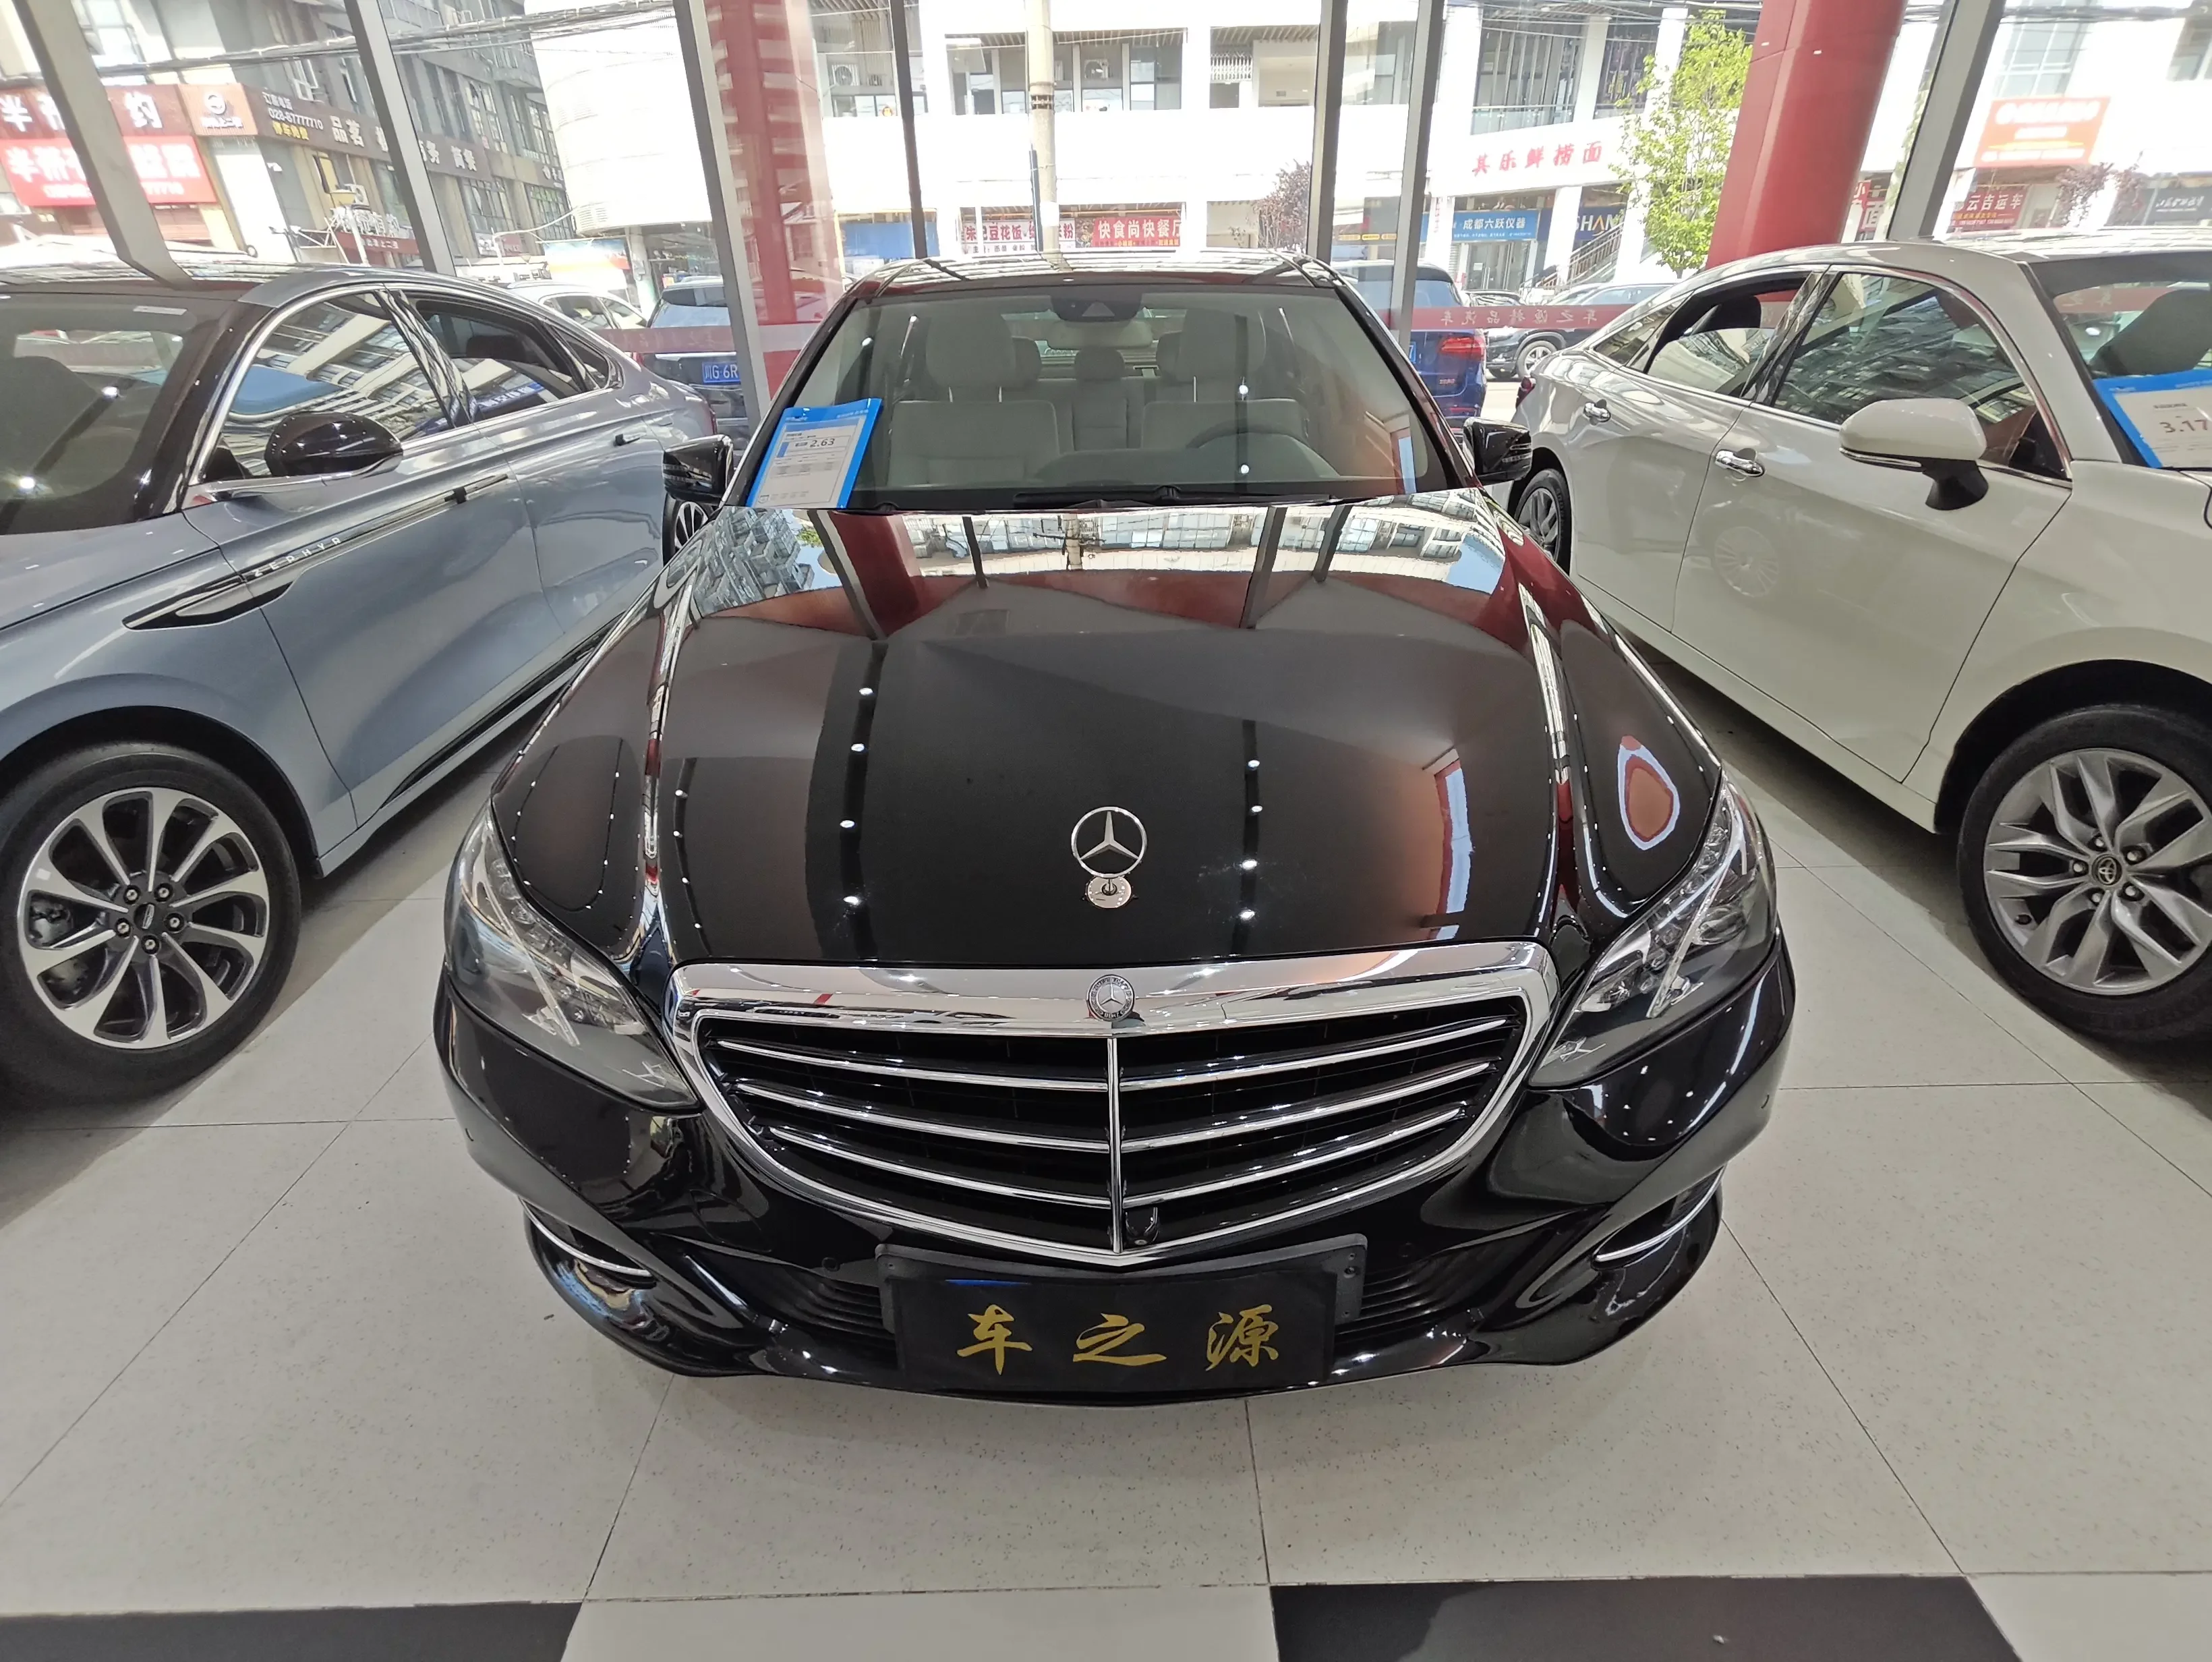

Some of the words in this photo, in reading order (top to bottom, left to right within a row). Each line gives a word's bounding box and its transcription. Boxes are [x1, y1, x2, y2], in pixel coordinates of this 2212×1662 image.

[1463, 217, 1526, 230] 成都六跃仪器
[809, 438, 836, 448] 2.63
[957, 1303, 1279, 1375] 车之源
